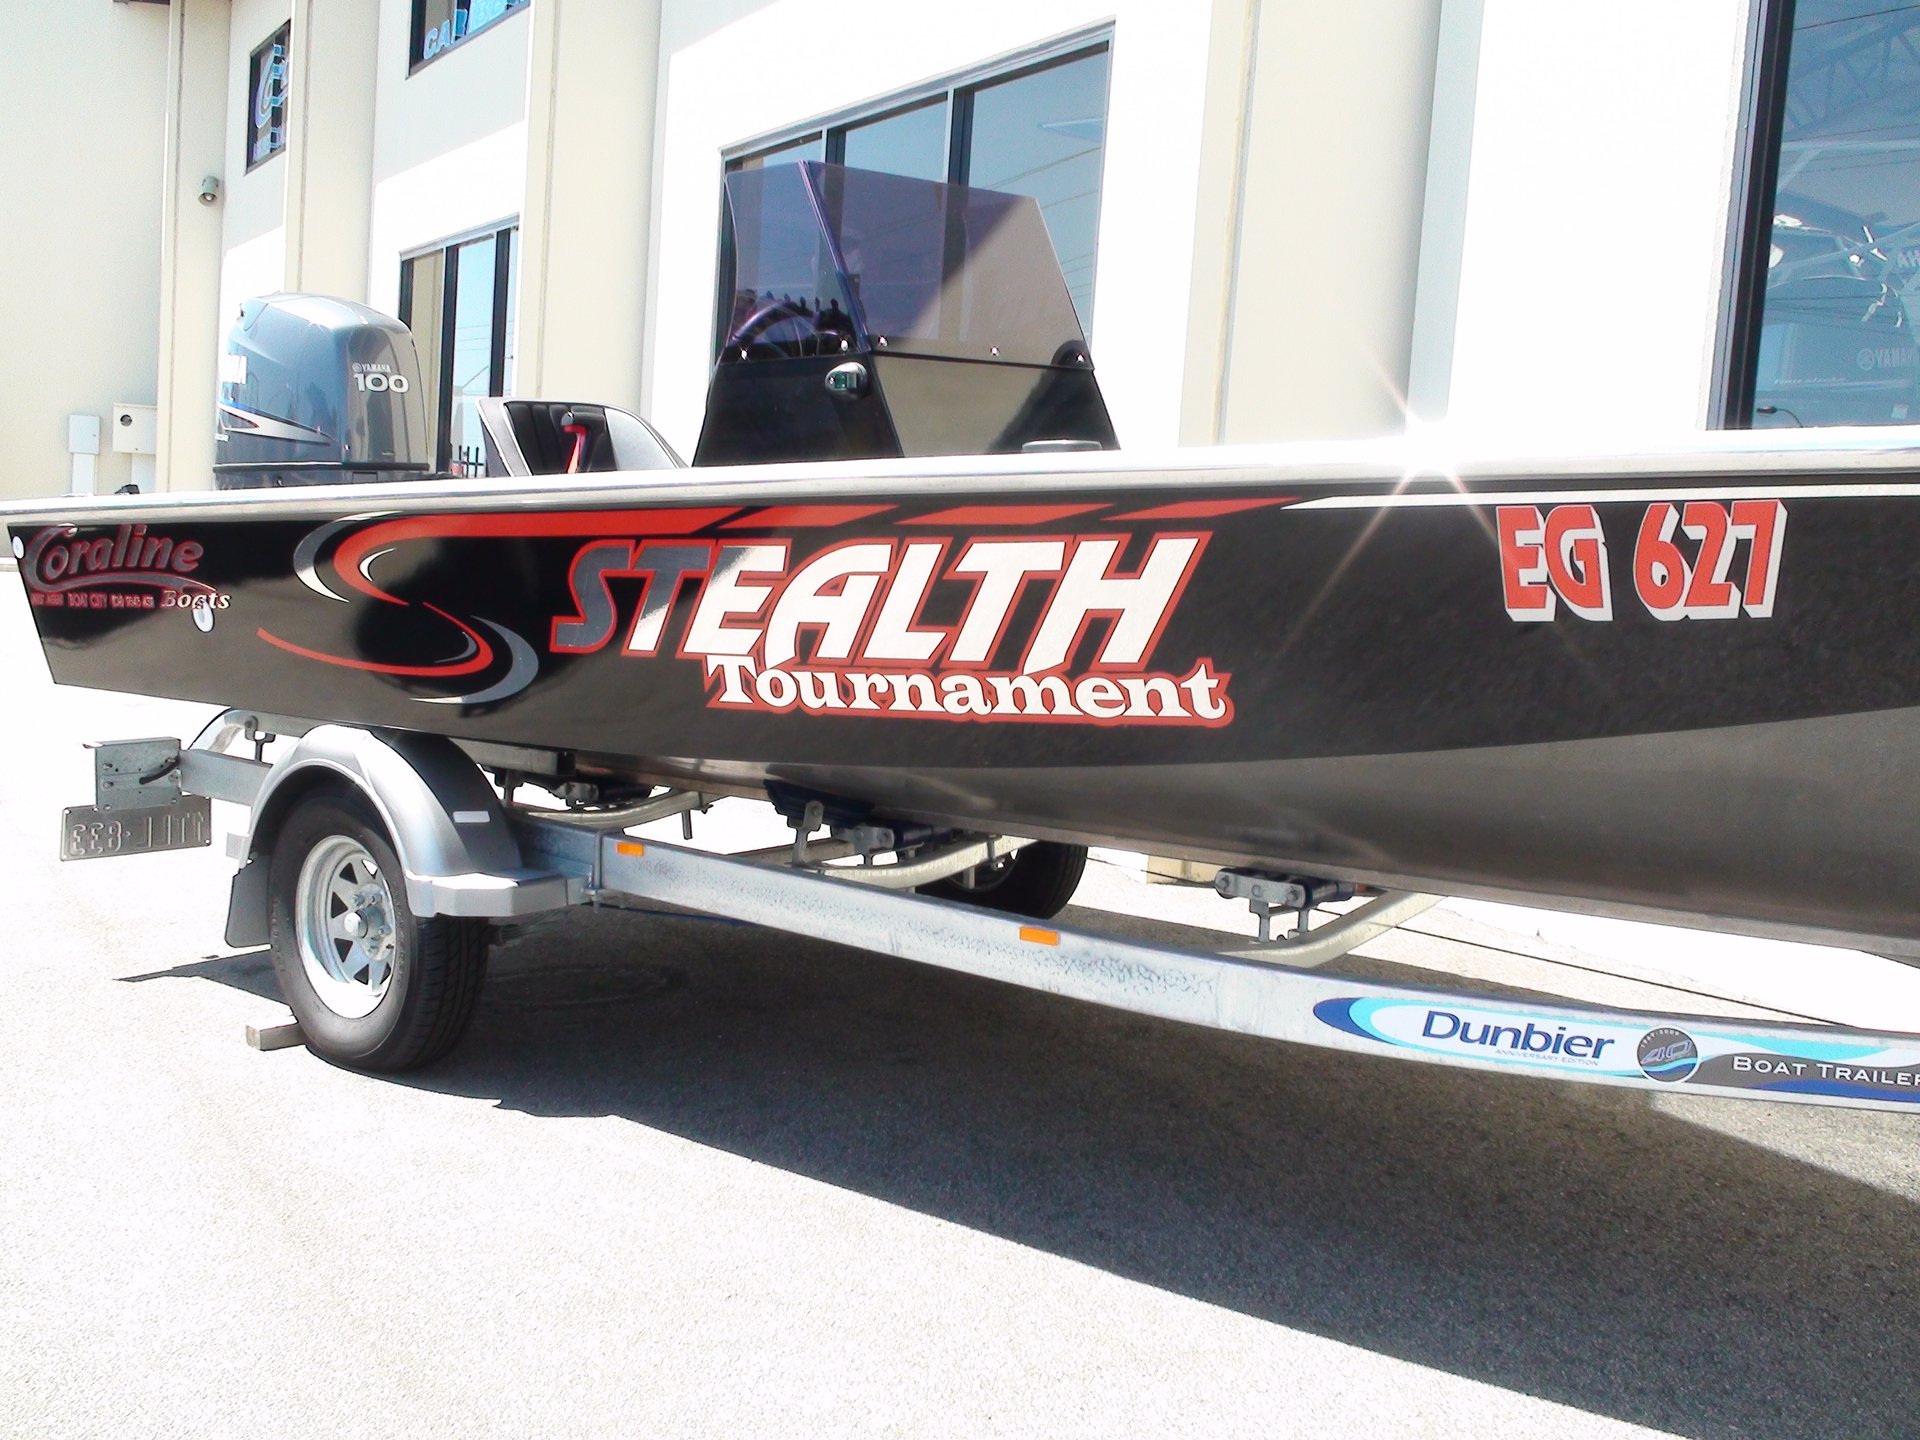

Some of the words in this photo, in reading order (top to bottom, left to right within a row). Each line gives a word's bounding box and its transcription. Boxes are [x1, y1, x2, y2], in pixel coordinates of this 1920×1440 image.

[353, 373, 409, 393] 100
[361, 363, 391, 373] YAMAHA
[24, 524, 204, 591] Coraline
[1496, 505, 1614, 621] EG
[1633, 499, 1788, 621] 627
[160, 590, 231, 609] Boats
[550, 531, 1213, 676] STEALTH
[706, 655, 1233, 726] Tournament
[1422, 1010, 1615, 1060] Dunbier
[1640, 1038, 1693, 1066] 40
[1495, 1049, 1559, 1062] ANNIVERSARY
[1561, 1056, 1599, 1067] EDITION
